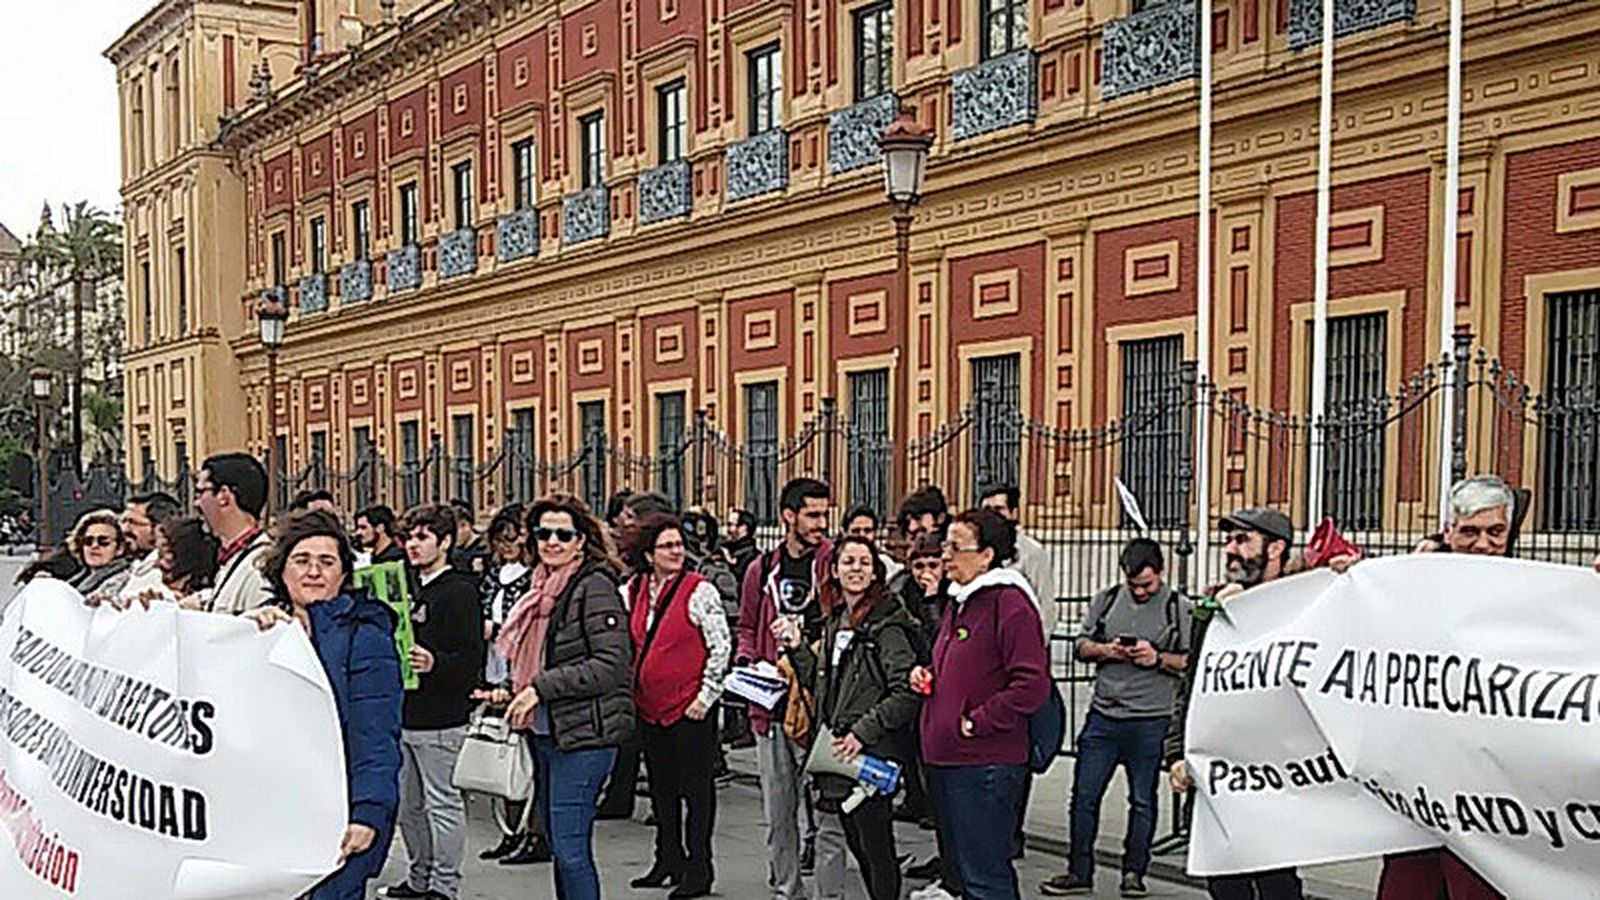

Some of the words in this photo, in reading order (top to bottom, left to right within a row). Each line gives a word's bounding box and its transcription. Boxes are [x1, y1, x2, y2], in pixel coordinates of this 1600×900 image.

[1202, 641, 1318, 693] FRENTE
[1320, 649, 1355, 698] A
[1384, 652, 1600, 722] PRECARIZA
[1209, 760, 1284, 796] Paso
[1414, 787, 1451, 832] de
[1455, 795, 1529, 836] AYD
[1534, 808, 1564, 848] y
